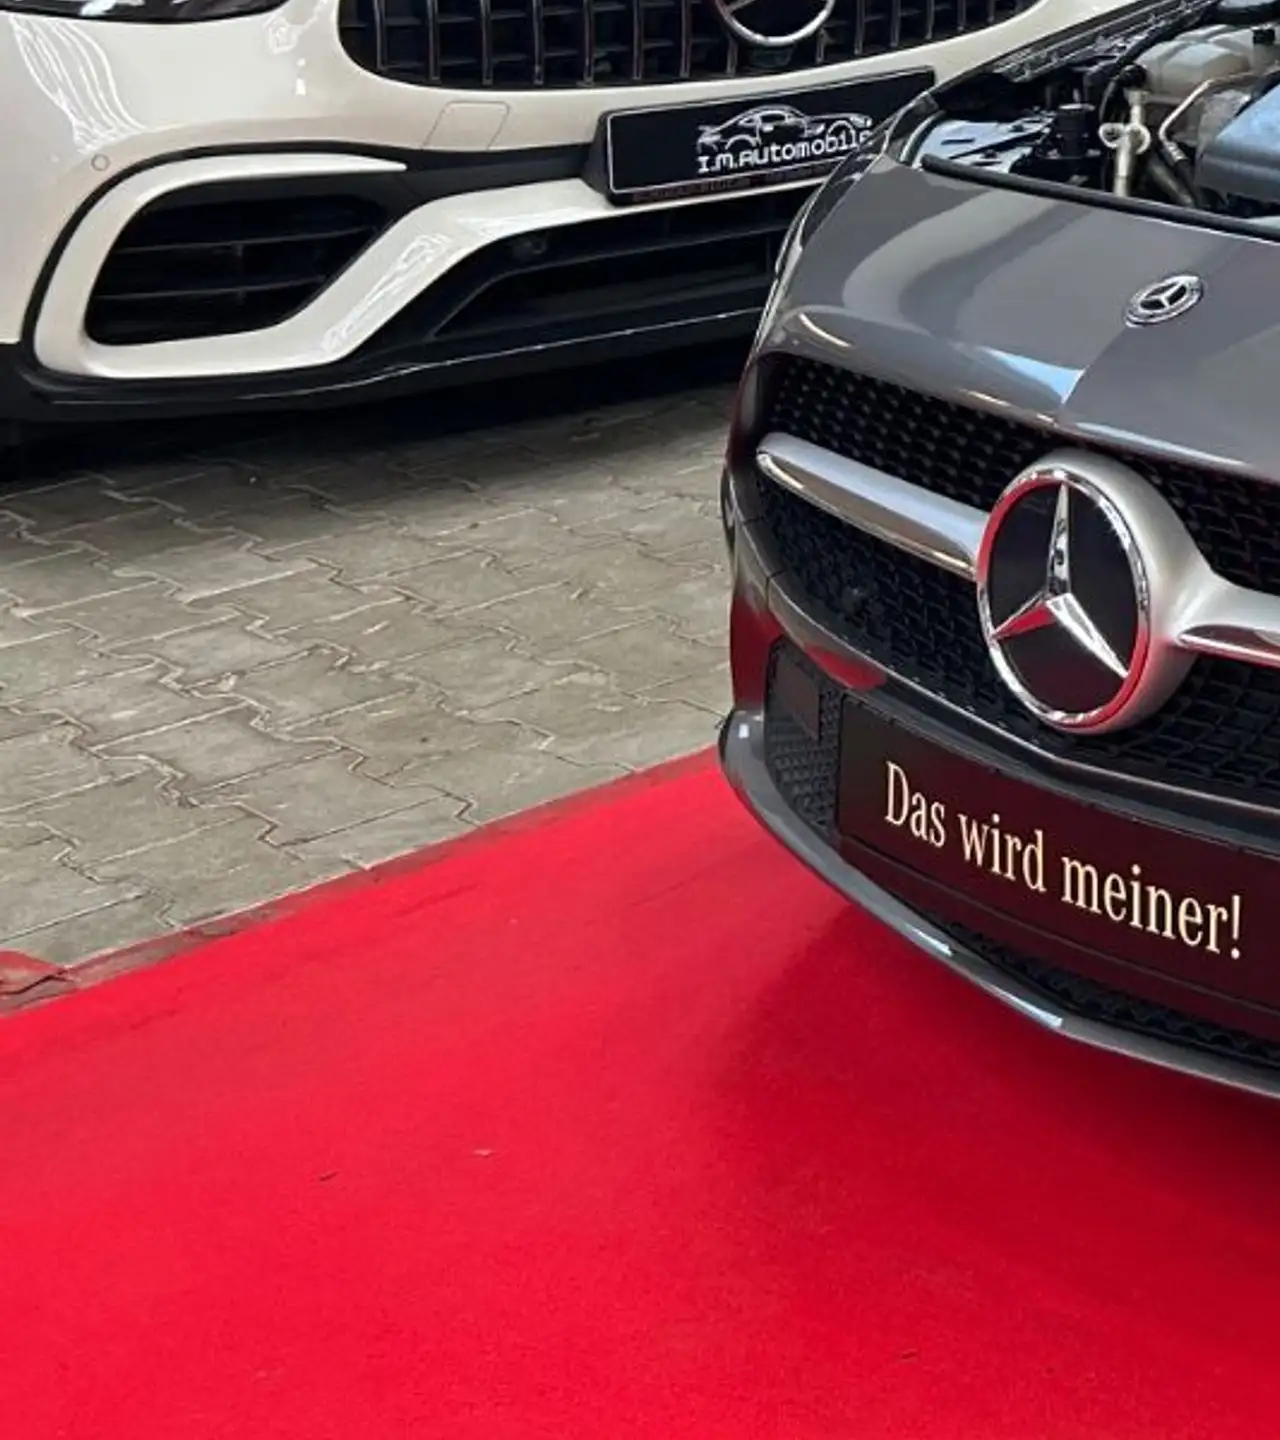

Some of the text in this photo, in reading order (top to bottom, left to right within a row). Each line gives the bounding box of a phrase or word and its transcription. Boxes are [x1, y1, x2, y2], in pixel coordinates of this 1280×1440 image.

[885, 761, 1241, 959] Das wird meiner!
